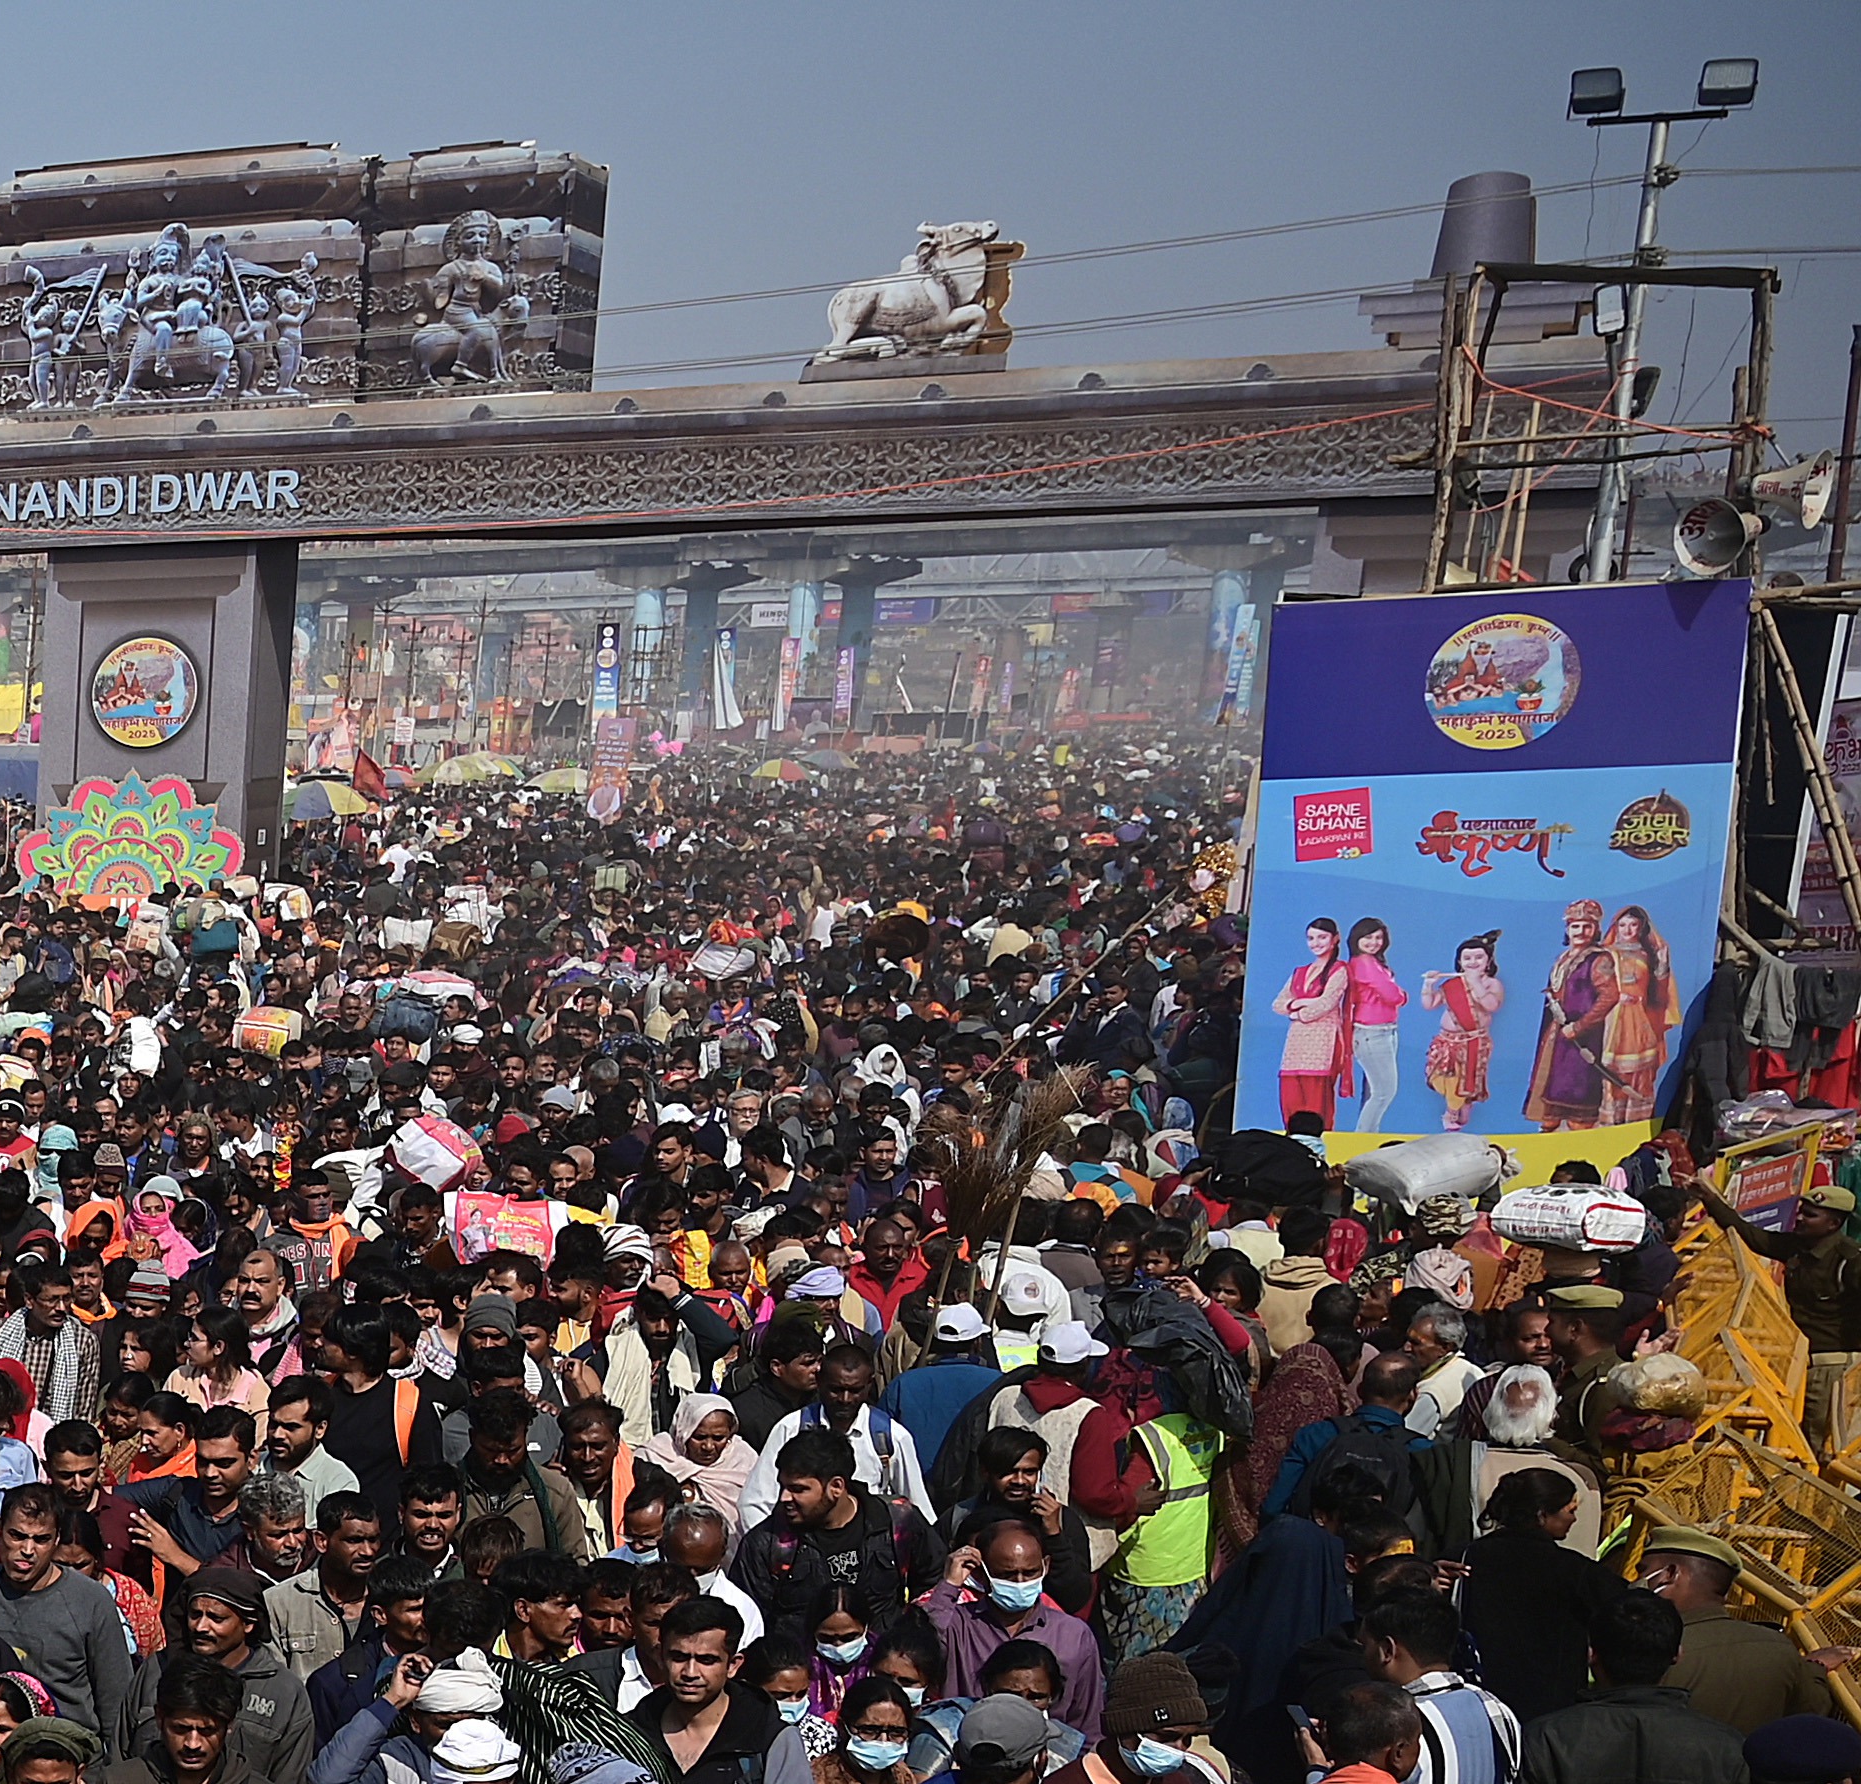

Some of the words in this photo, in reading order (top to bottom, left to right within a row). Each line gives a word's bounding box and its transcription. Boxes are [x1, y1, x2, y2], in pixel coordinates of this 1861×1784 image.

[150, 470, 300, 513] DWAR
[128, 730, 156, 739] 2025
[1475, 730, 1517, 740] 2025
[1304, 803, 1361, 818] SAPNE
[1297, 816, 1367, 831] SUHANE
[1622, 811, 1679, 831] जोधा
[1608, 830, 1690, 849] अकबर
